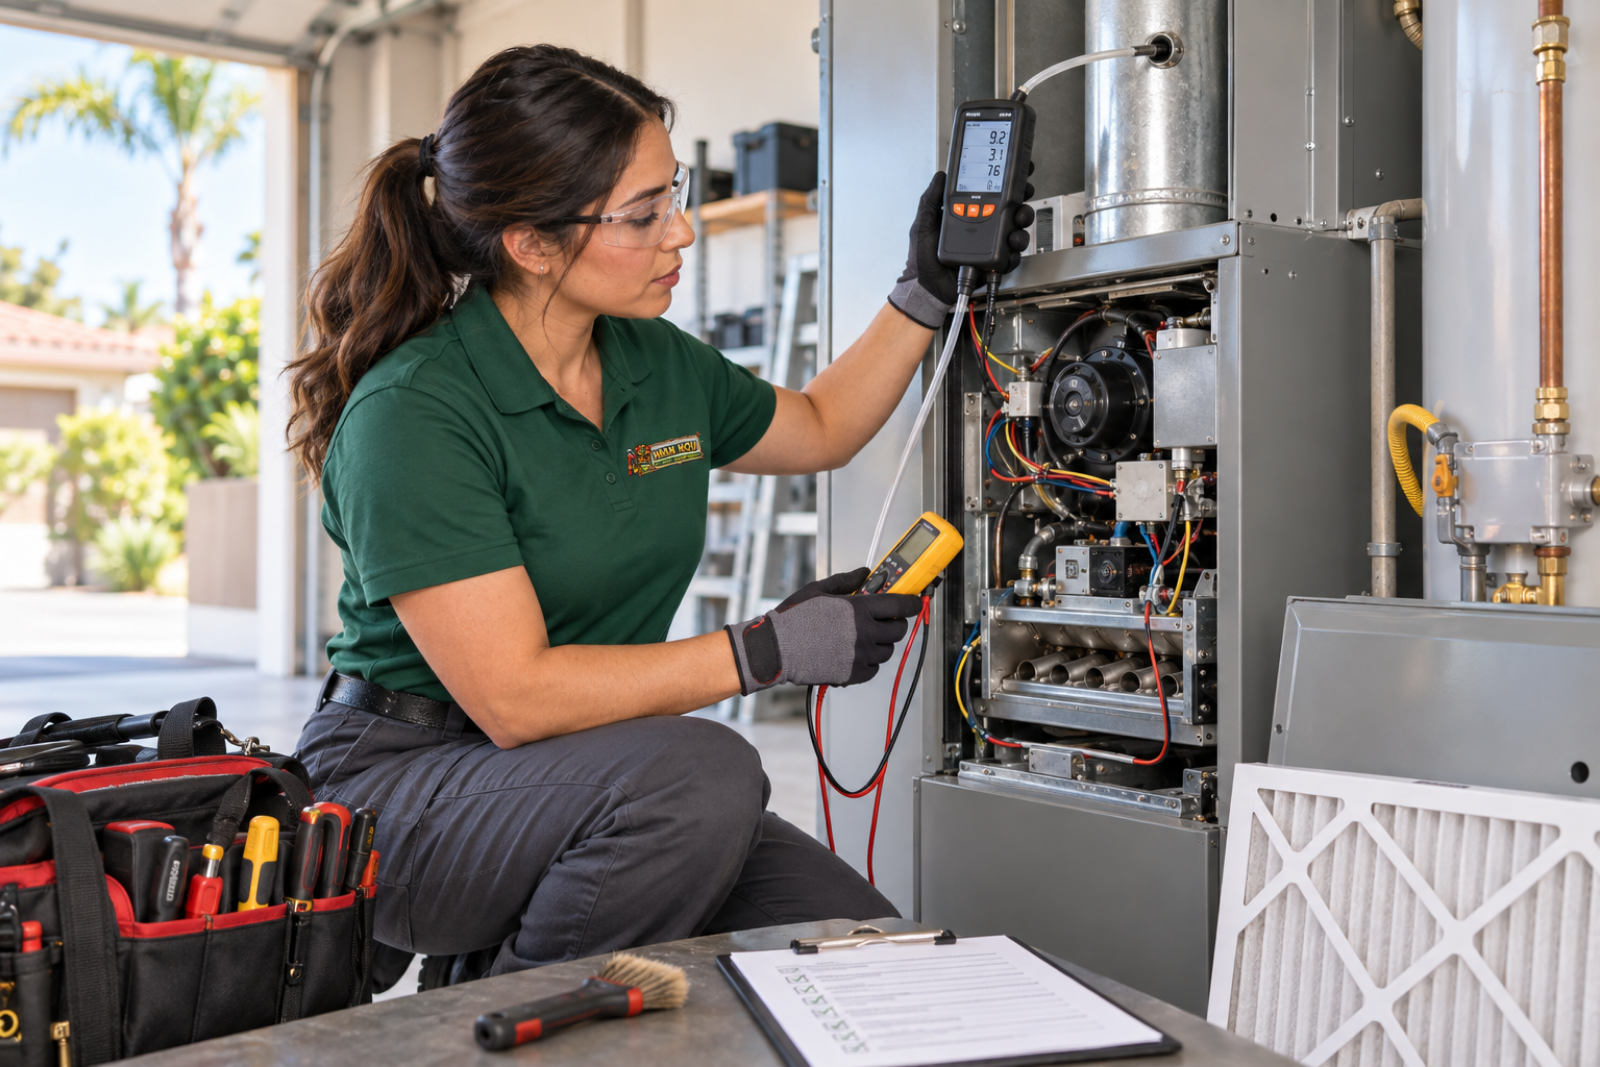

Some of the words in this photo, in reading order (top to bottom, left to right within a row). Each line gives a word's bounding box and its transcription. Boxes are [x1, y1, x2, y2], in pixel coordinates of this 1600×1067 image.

[989, 130, 1006, 144] 9.2
[988, 148, 1003, 161] 3.1
[988, 164, 1001, 176] 76
